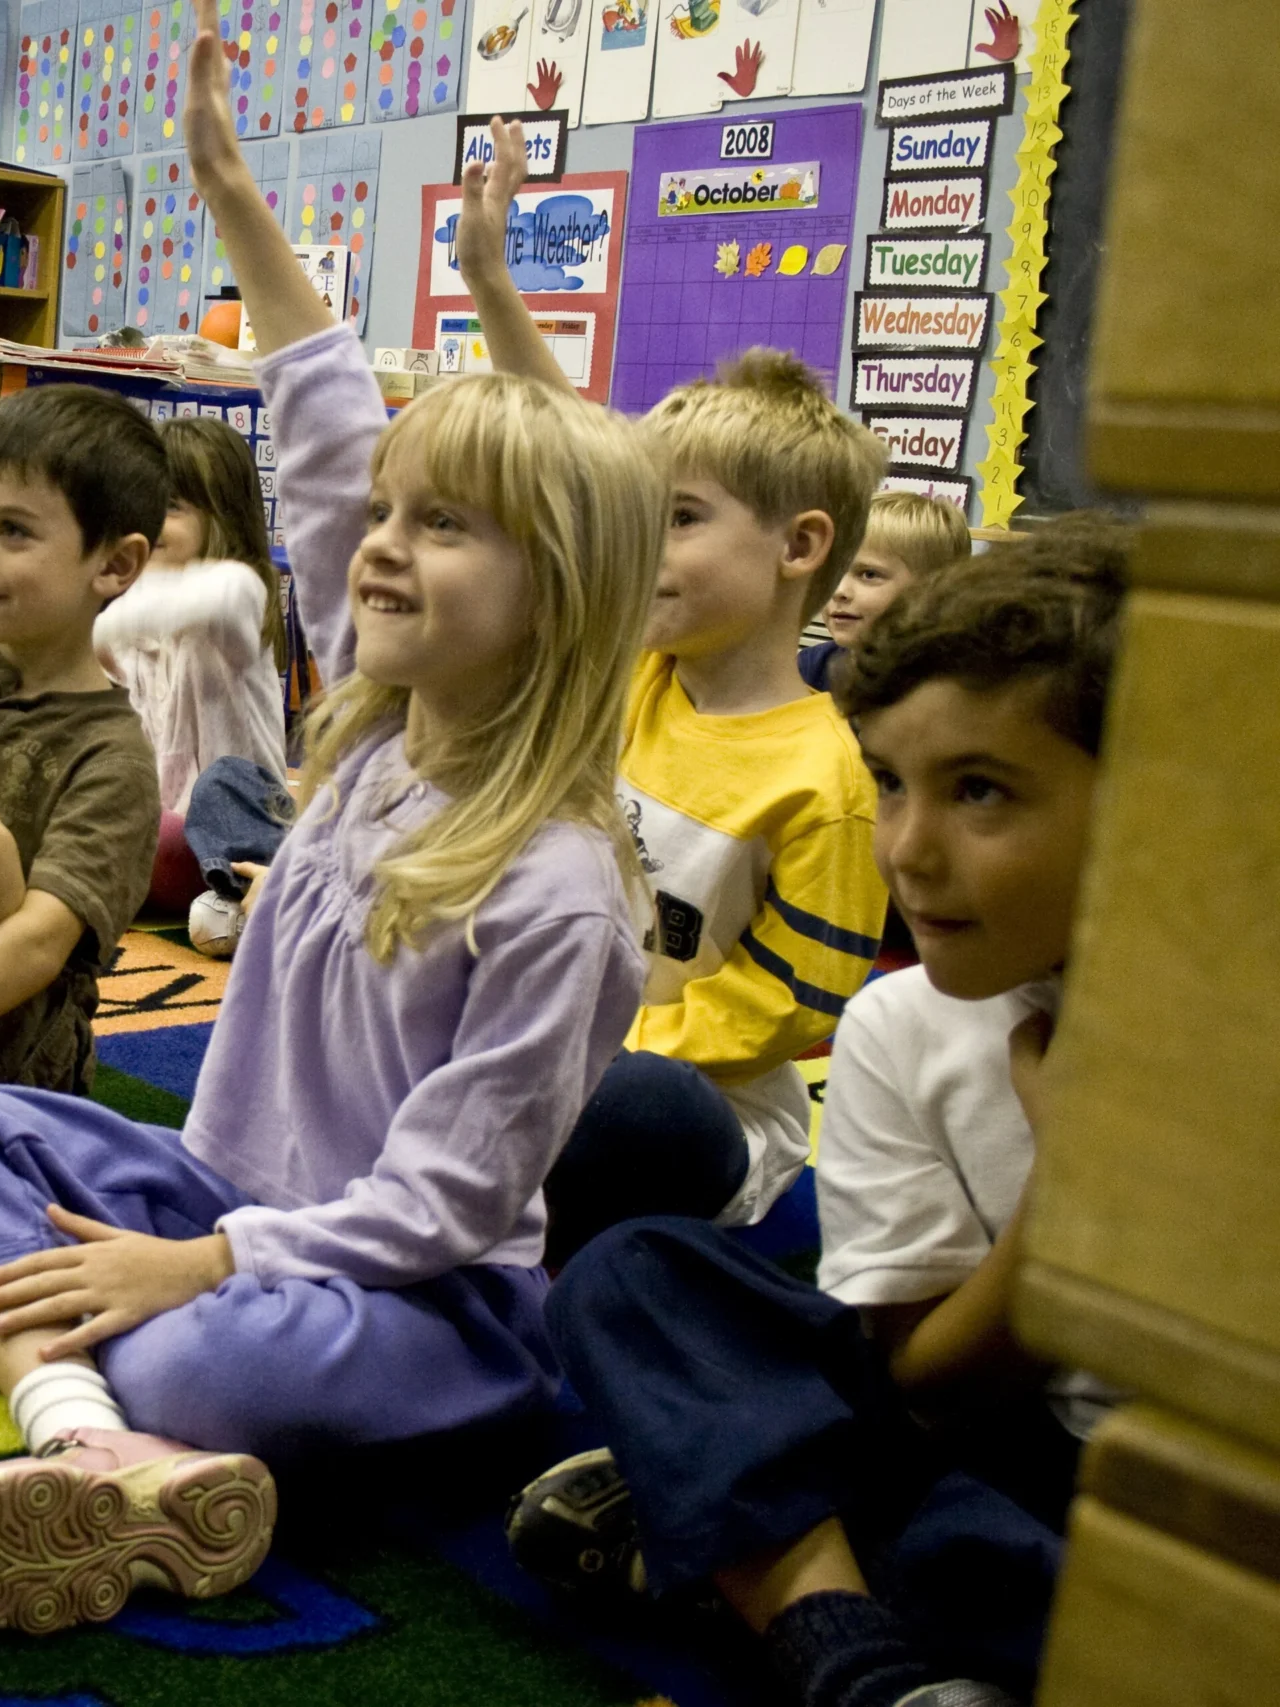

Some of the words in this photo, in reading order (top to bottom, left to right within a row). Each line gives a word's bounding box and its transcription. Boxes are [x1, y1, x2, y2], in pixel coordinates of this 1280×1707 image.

[1044, 17, 1060, 40] 15
[1042, 53, 1060, 73] 14
[888, 95, 917, 110] Days
[919, 90, 933, 104] of
[936, 87, 956, 101] the
[962, 81, 997, 99] Week
[1037, 86, 1051, 103] 13
[724, 125, 770, 156] 2008
[1030, 120, 1048, 142] 12
[465, 133, 552, 163] Alpets
[896, 129, 981, 165] Sunday
[694, 181, 778, 206] October
[889, 185, 975, 222] Monday
[1022, 188, 1039, 208] 10
[532, 209, 609, 263] Weather?
[1021, 222, 1032, 240] 9
[875, 243, 979, 285] Tuesday
[1020, 260, 1031, 278] 8
[1017, 294, 1028, 310] 7
[863, 302, 983, 345] Wednesday
[1010, 332, 1022, 348] 6
[861, 363, 966, 402] Thursday
[1006, 366, 1017, 383] 5
[157, 405, 167, 422] 5
[235, 411, 245, 429] 8
[995, 427, 1008, 447] 3
[258, 445, 274, 462] 19
[991, 466, 1001, 484] 2
[996, 494, 1002, 511] 1
